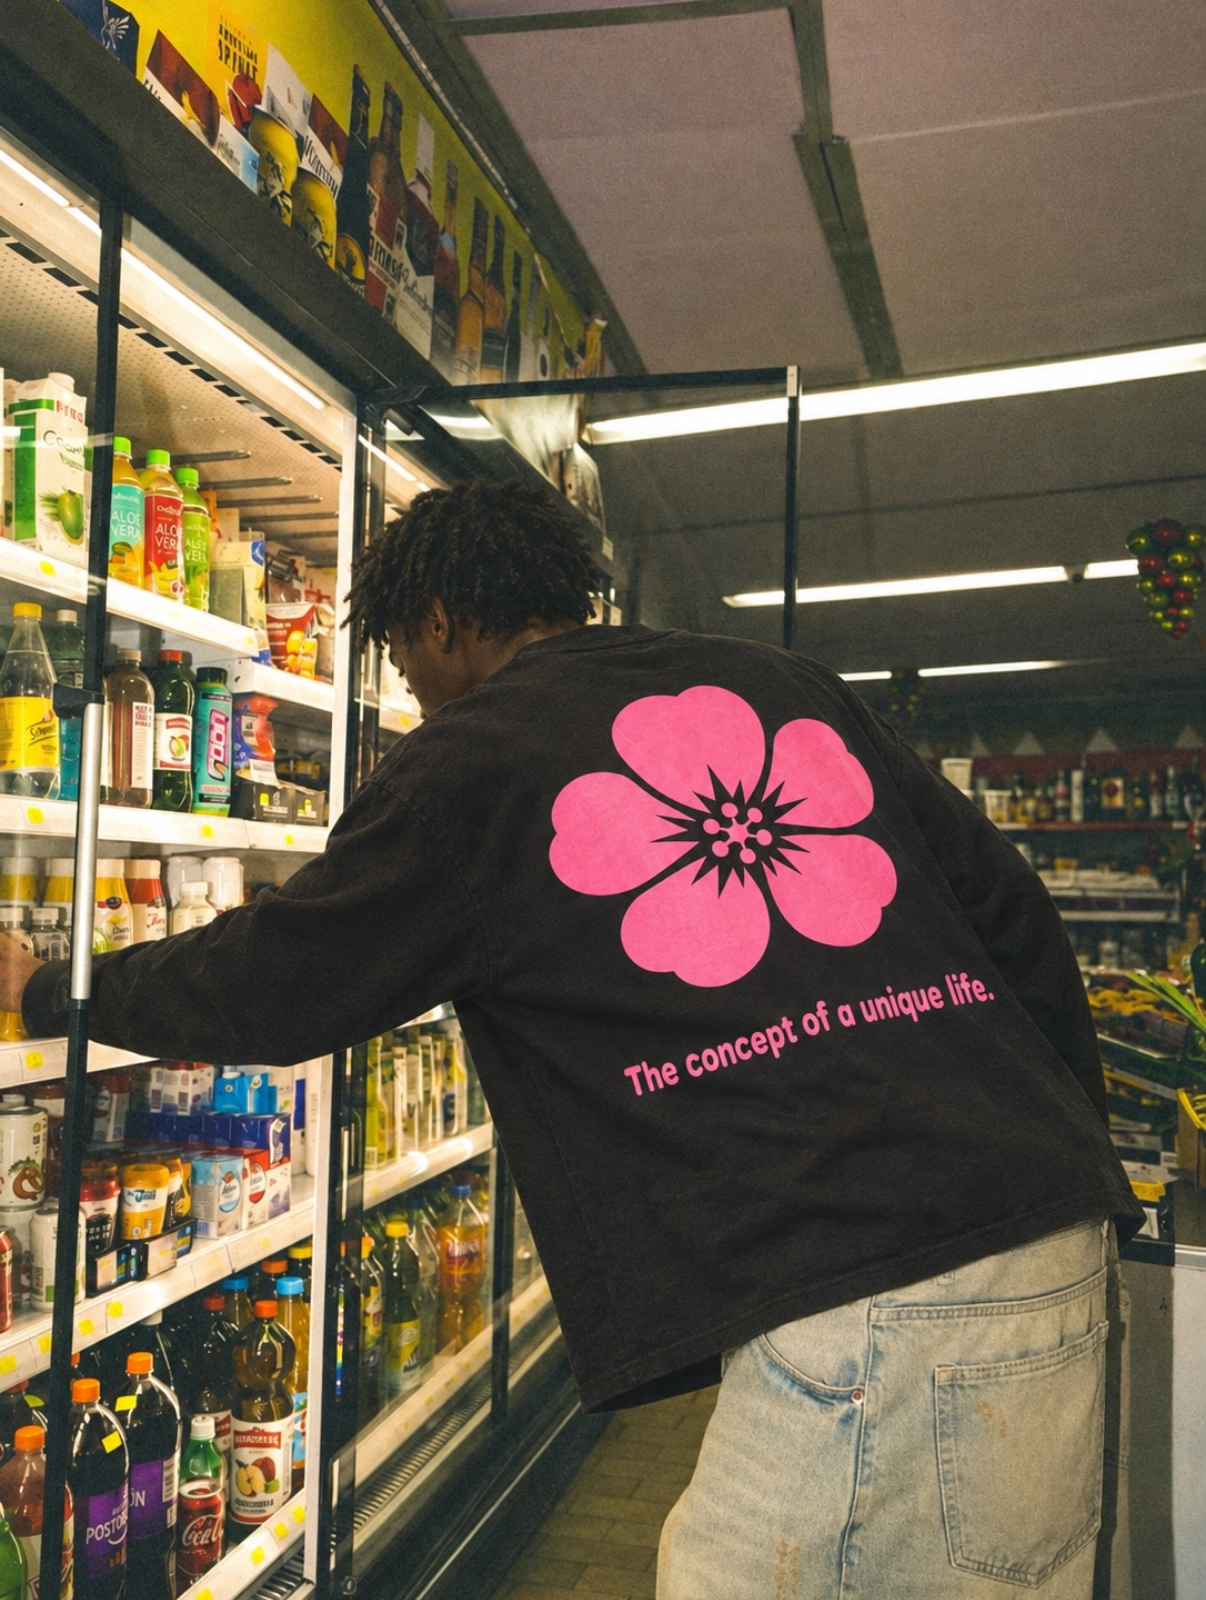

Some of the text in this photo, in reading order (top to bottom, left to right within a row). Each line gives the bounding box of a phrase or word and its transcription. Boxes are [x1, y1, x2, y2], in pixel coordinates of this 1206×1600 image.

[155, 536, 180, 550] VER
[623, 972, 995, 1096] The concept of a unique life.
